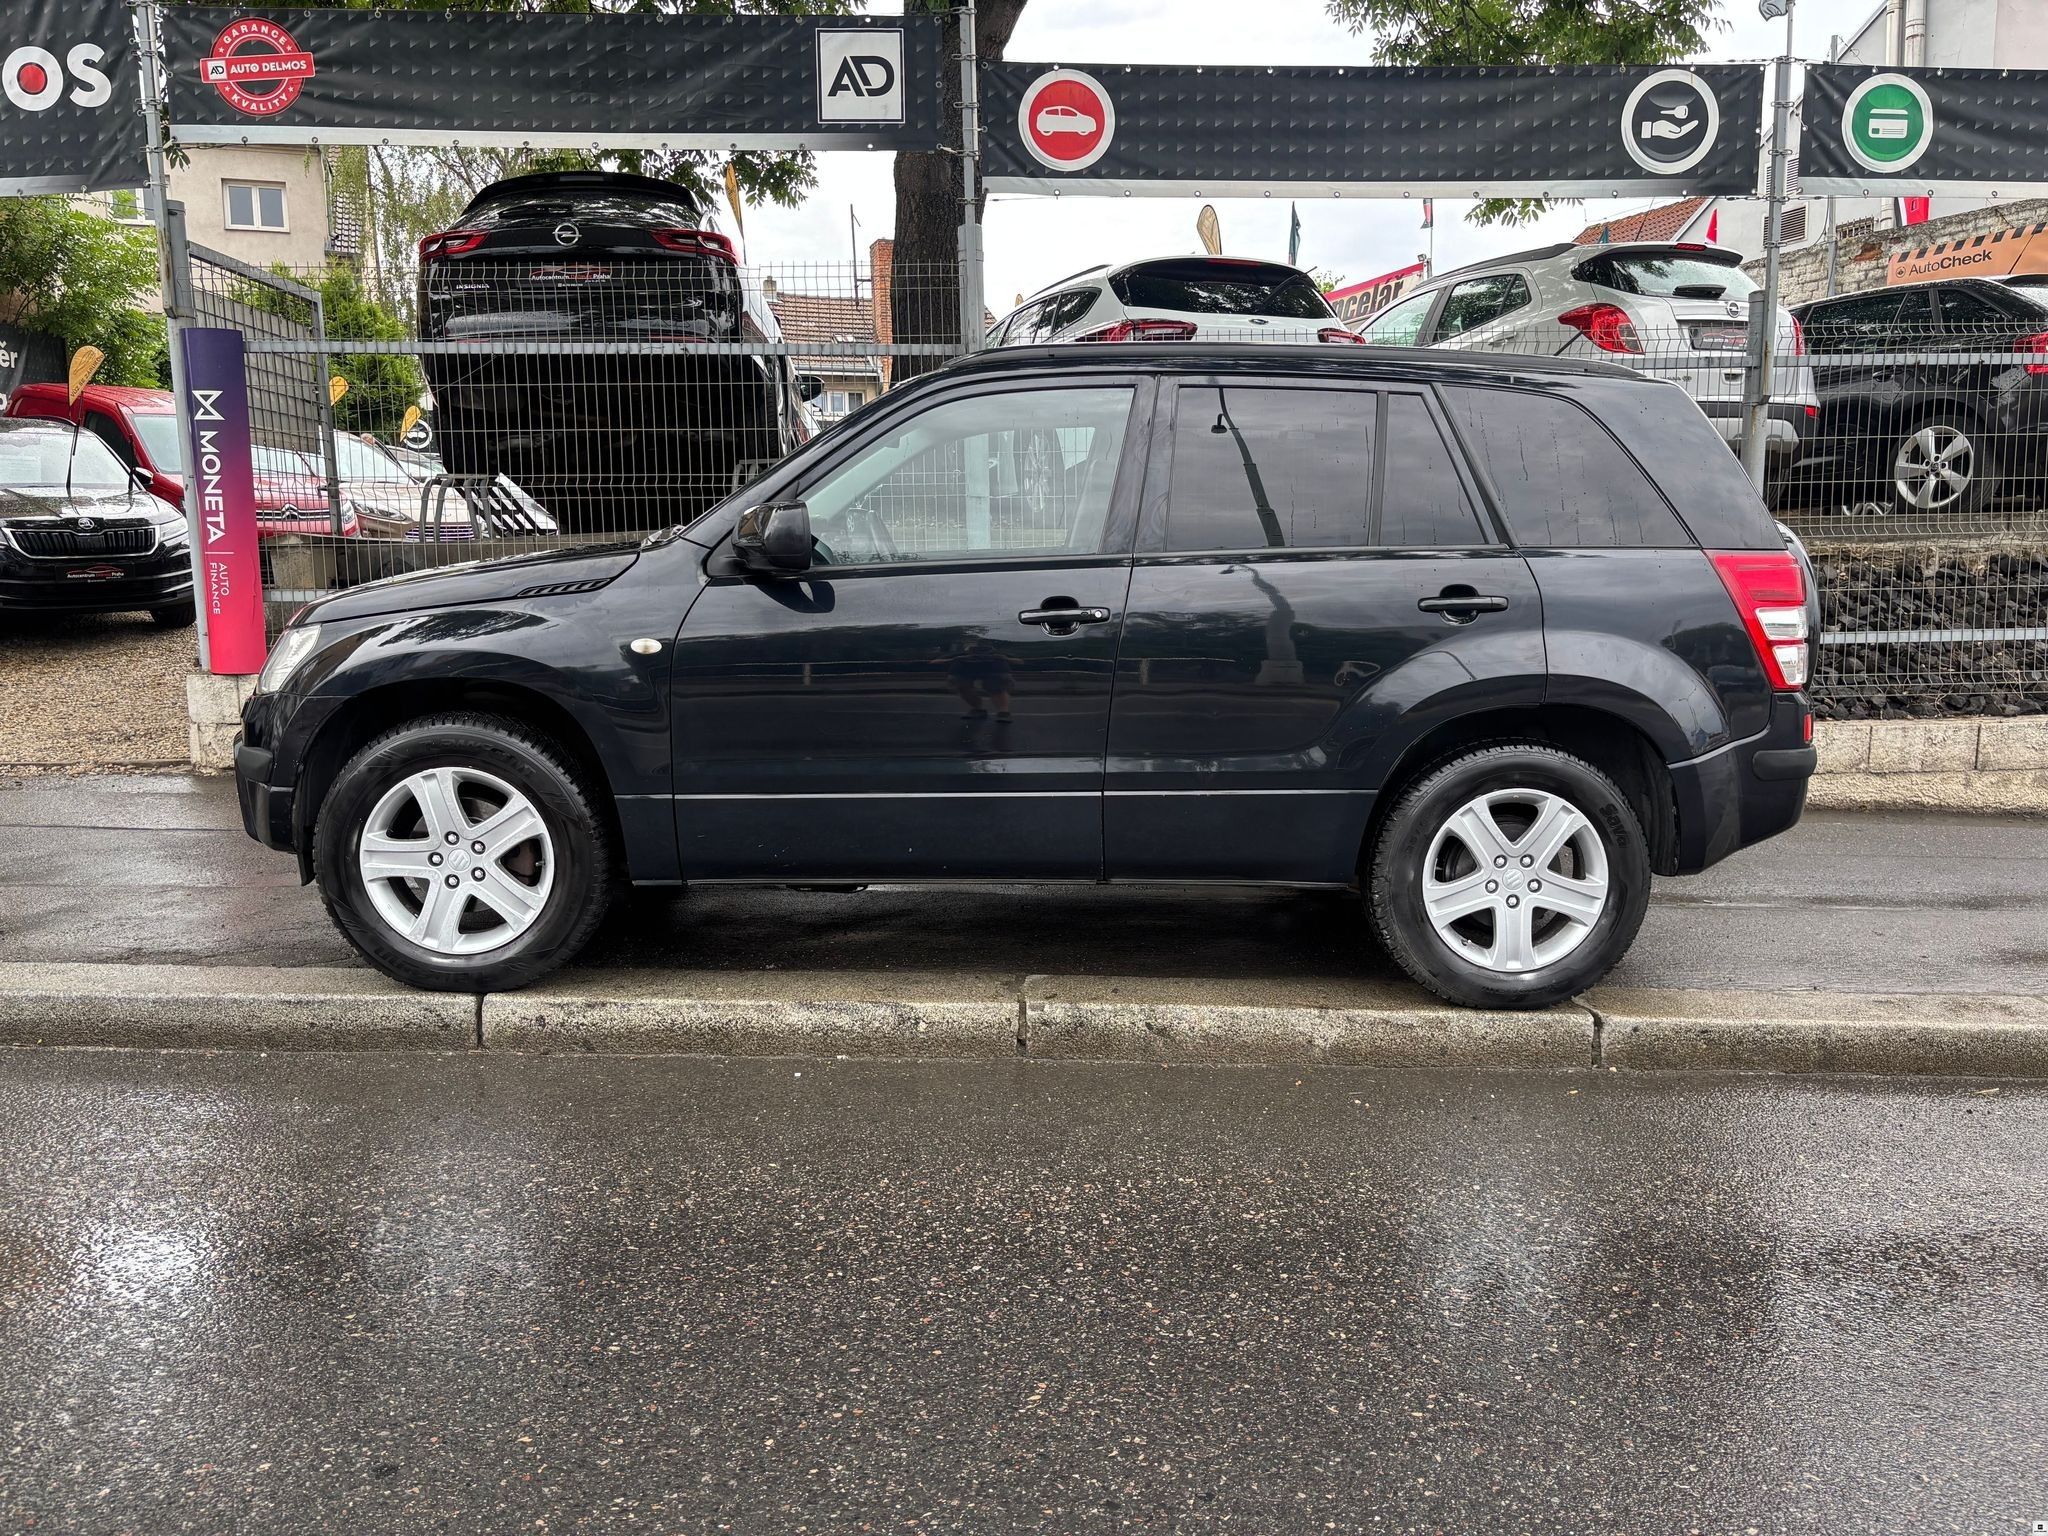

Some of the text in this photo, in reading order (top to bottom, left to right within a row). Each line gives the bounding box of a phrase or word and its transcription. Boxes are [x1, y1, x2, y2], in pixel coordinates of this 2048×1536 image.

[223, 24, 288, 45] GARANCE
[230, 63, 259, 74] AUTO
[262, 60, 307, 72] DELMOS
[827, 55, 895, 97] AD
[231, 93, 287, 111] KVALITY
[1908, 249, 1993, 277] AutoCheck
[200, 430, 226, 545] MONETA
[209, 561, 221, 616] FINANCE
[218, 562, 230, 597] AUTO
